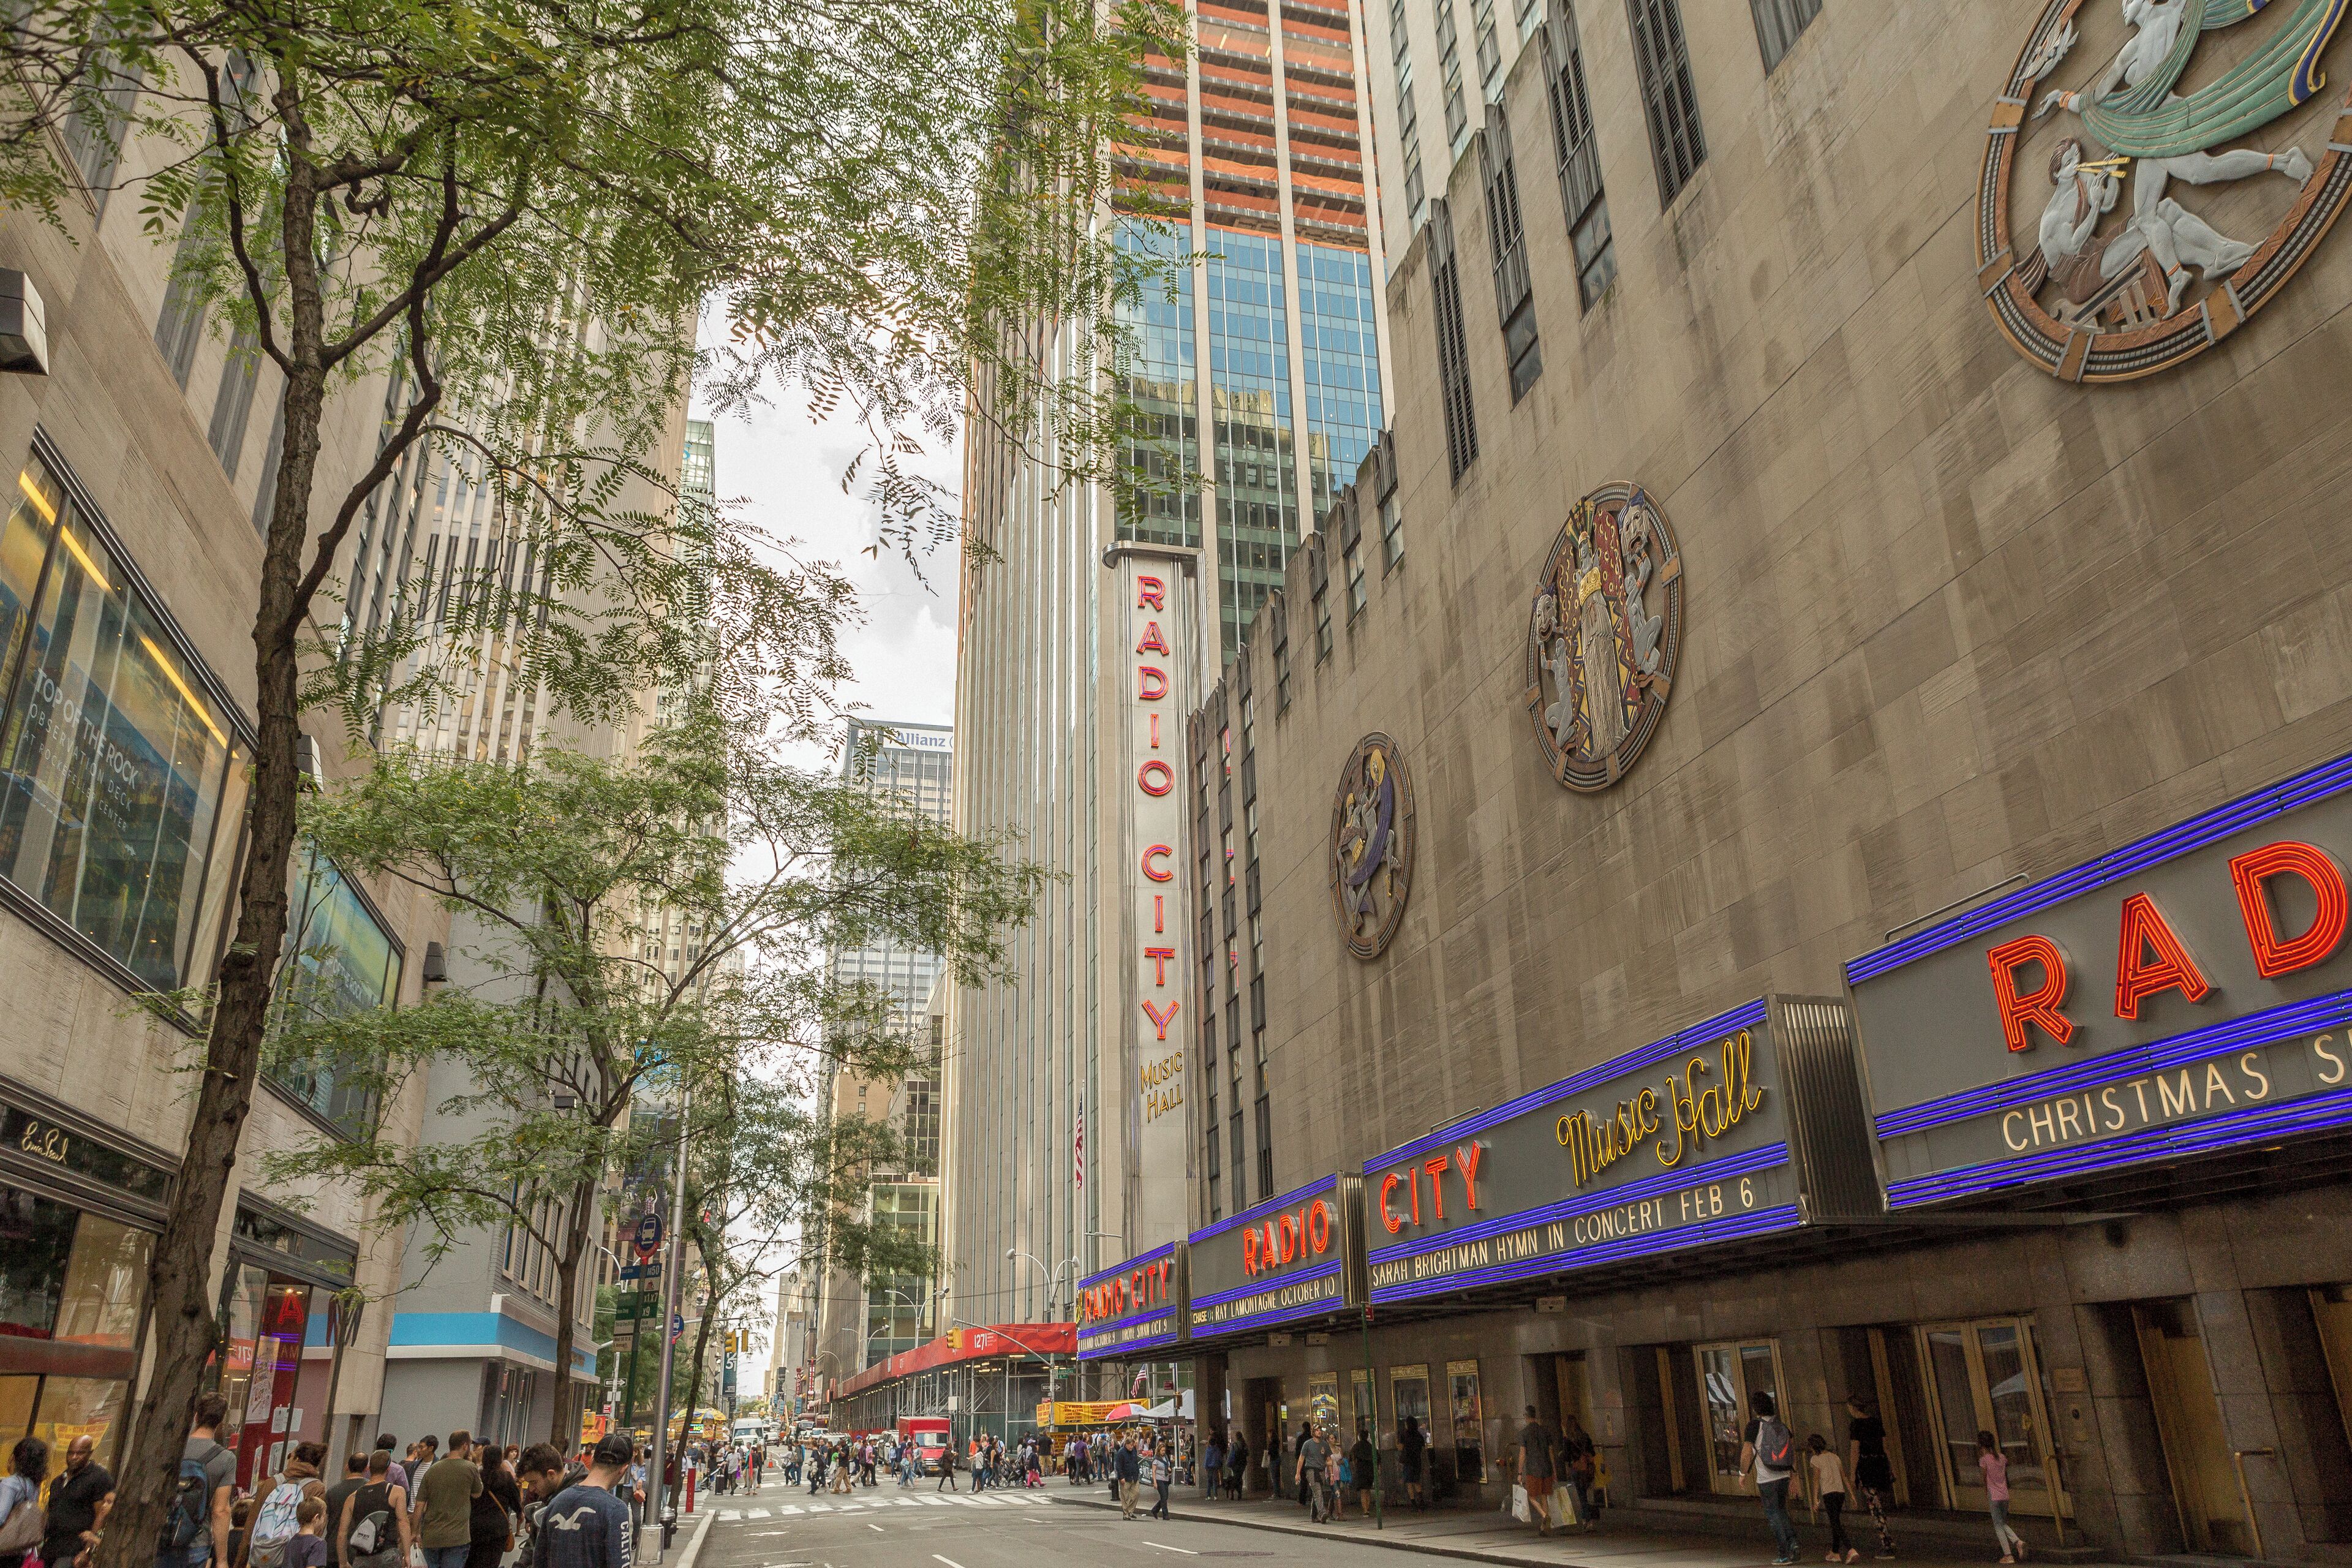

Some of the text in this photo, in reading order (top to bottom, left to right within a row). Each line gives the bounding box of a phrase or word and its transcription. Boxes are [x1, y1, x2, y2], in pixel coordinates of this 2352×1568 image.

[37, 667, 139, 790] TOP OF THE ROCK
[1136, 575, 1175, 797] RADIO
[23, 730, 127, 832] AT ROCKEFELLER CENTER
[30, 704, 132, 812] OBSERVATION DECK
[896, 732, 946, 747] Allianz
[1141, 843, 1180, 1040] CITY
[1556, 1028, 1764, 1188] Music Hall
[2002, 1028, 2352, 1153] CHRISTMAS S
[1372, 1177, 1754, 1287] SARAH BRIGHTMAN HYMN IN CONCERT FEB 6
[1380, 1140, 1483, 1234] CITY
[647, 1265, 660, 1276] M50
[1243, 1199, 1330, 1276] RADIO
[1085, 1258, 1170, 1324] RADIO CITY
[1122, 1328, 1135, 1341] TROYE
[1137, 1323, 1150, 1338] SIVAN
[1152, 1319, 1162, 1335] OCT
[1164, 1318, 1168, 1332] 9
[1193, 1275, 1335, 1325] CHASE RAY LAMONTAGNE OCTOBER 10
[974, 1333, 987, 1351] 1271
